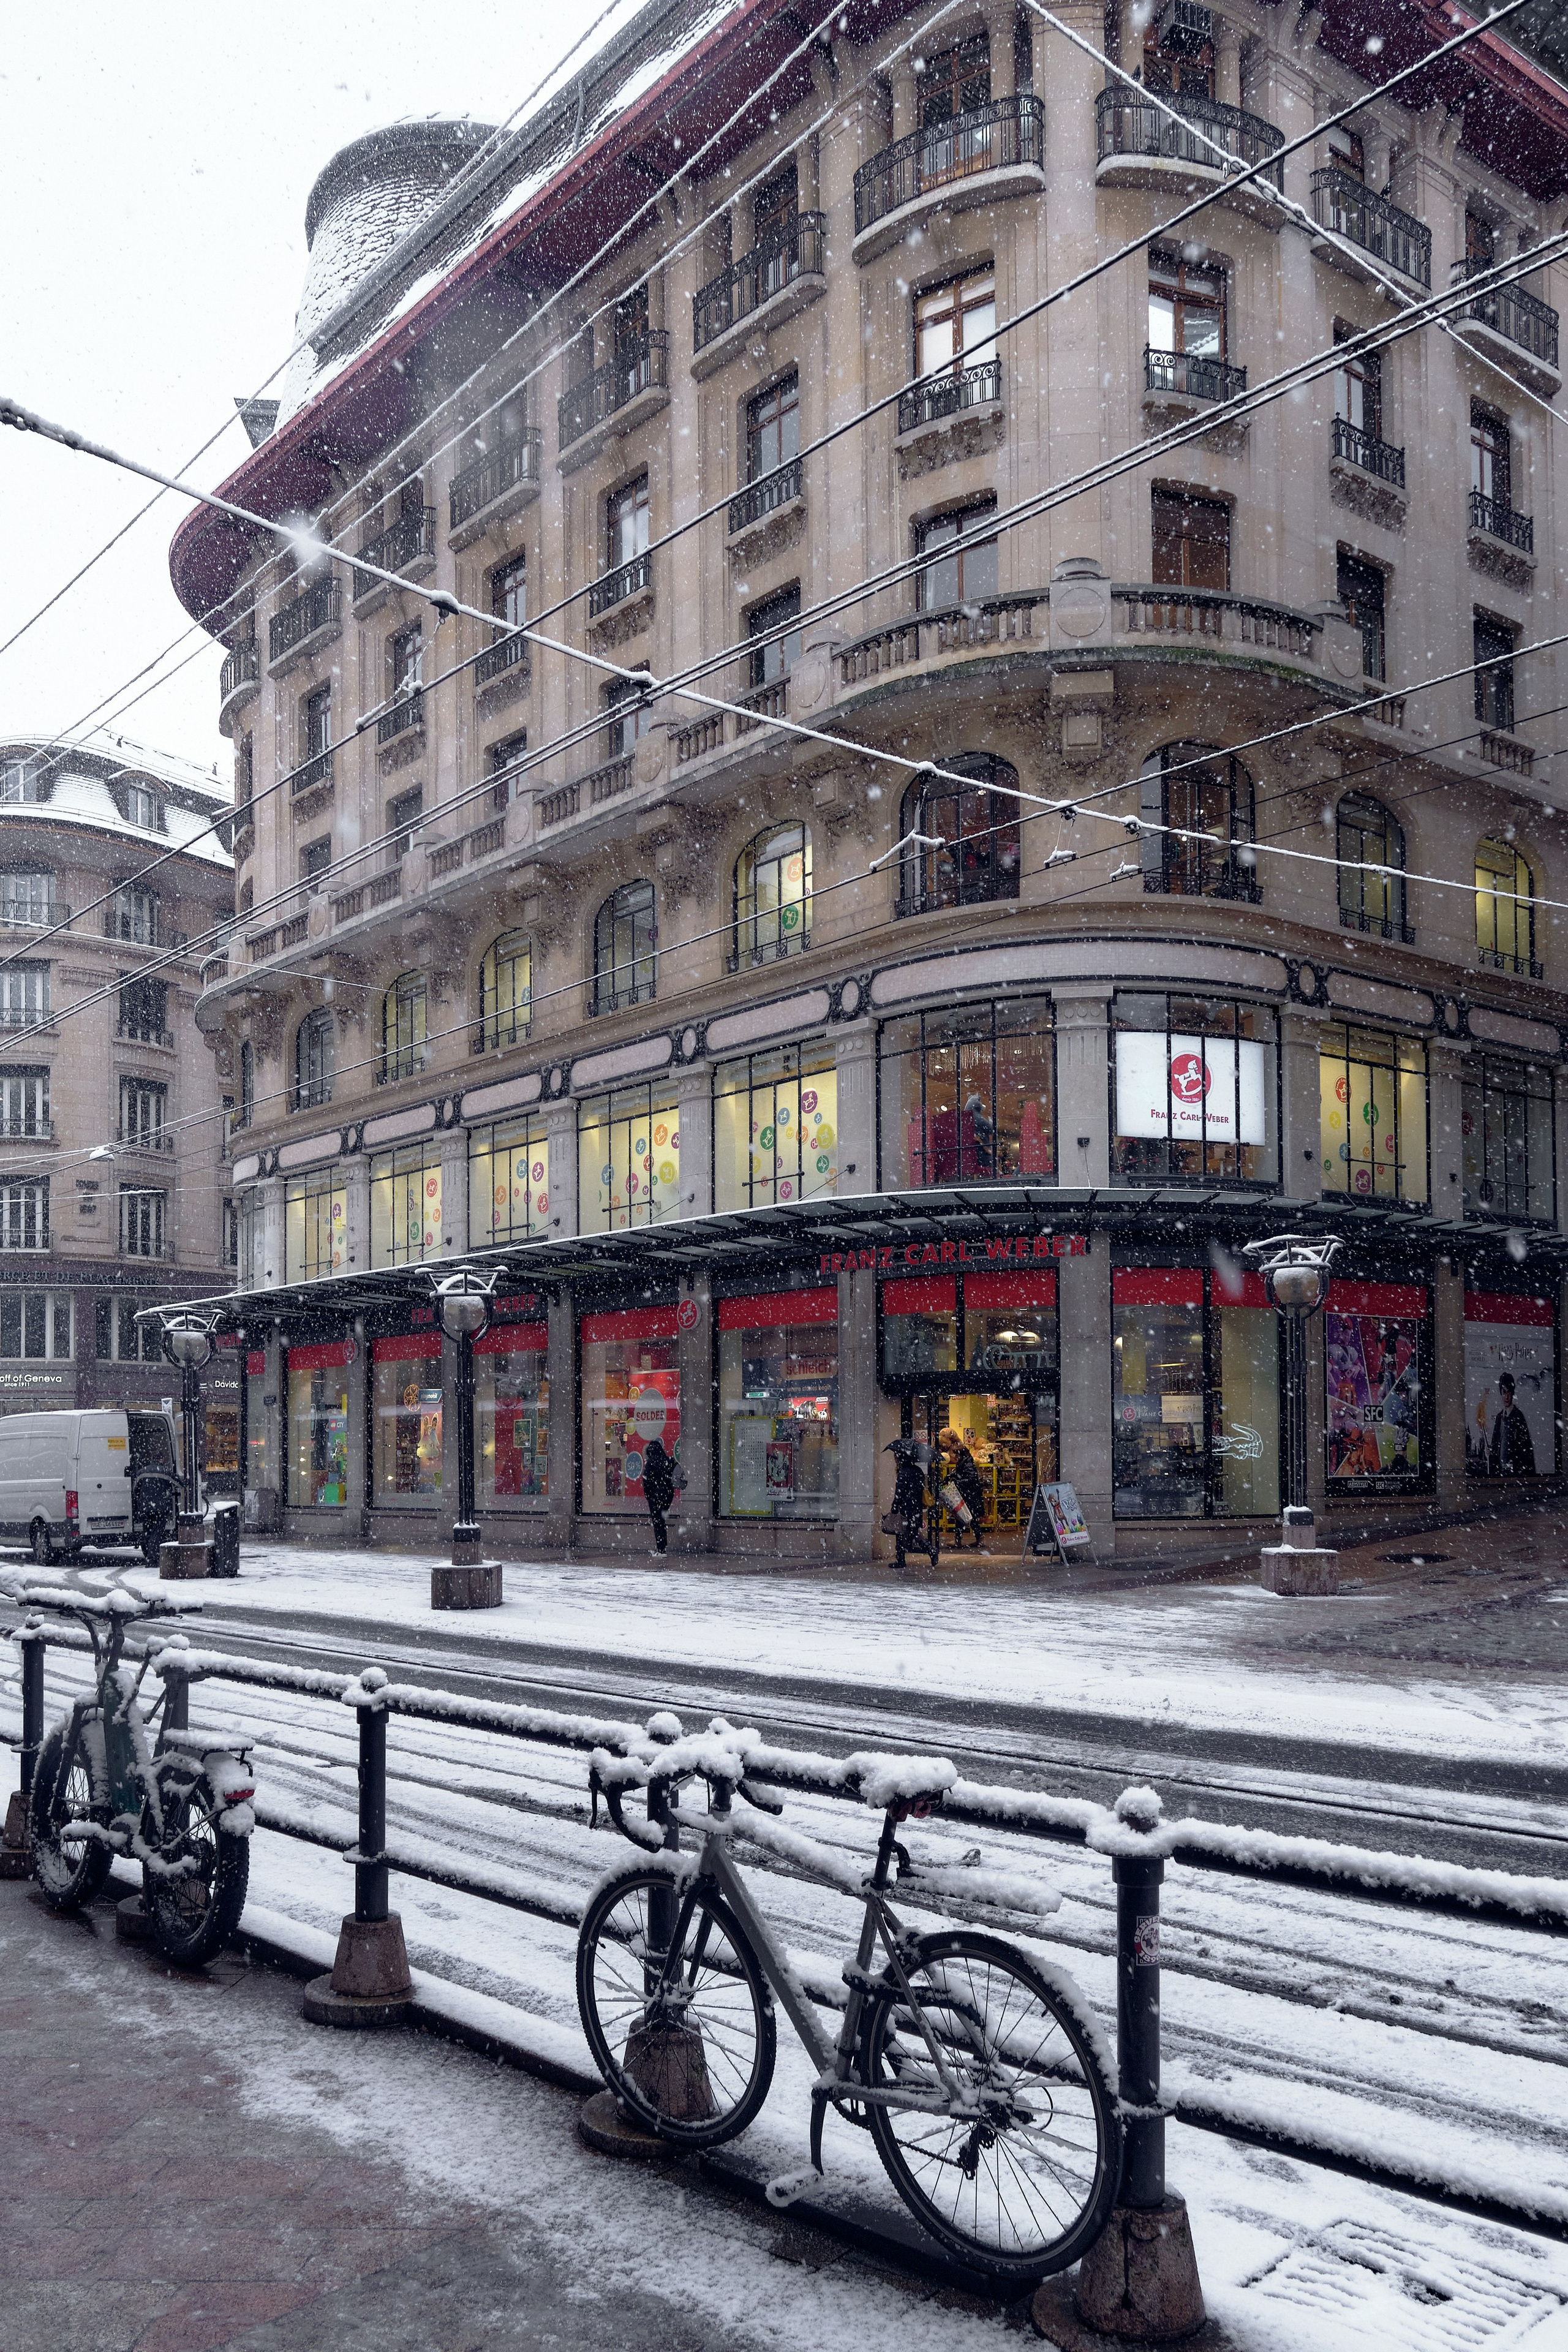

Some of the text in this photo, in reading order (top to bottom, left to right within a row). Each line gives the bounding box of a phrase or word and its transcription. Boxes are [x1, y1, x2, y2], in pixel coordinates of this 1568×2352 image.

[1151, 1109, 1177, 1120] FRAZ
[1180, 1111, 1200, 1121] CARL
[821, 1246, 894, 1275] FRANZ
[904, 1240, 973, 1265] CARL
[984, 1235, 1088, 1261] WEBER
[56, 1272, 74, 1281] DE
[411, 1307, 434, 1324] FRA
[786, 1359, 832, 1376] schleich
[13, 1374, 22, 1382] of
[24, 1374, 62, 1383] Geneva
[636, 1410, 665, 1422] SOLDES
[1365, 1406, 1382, 1422] SFC
